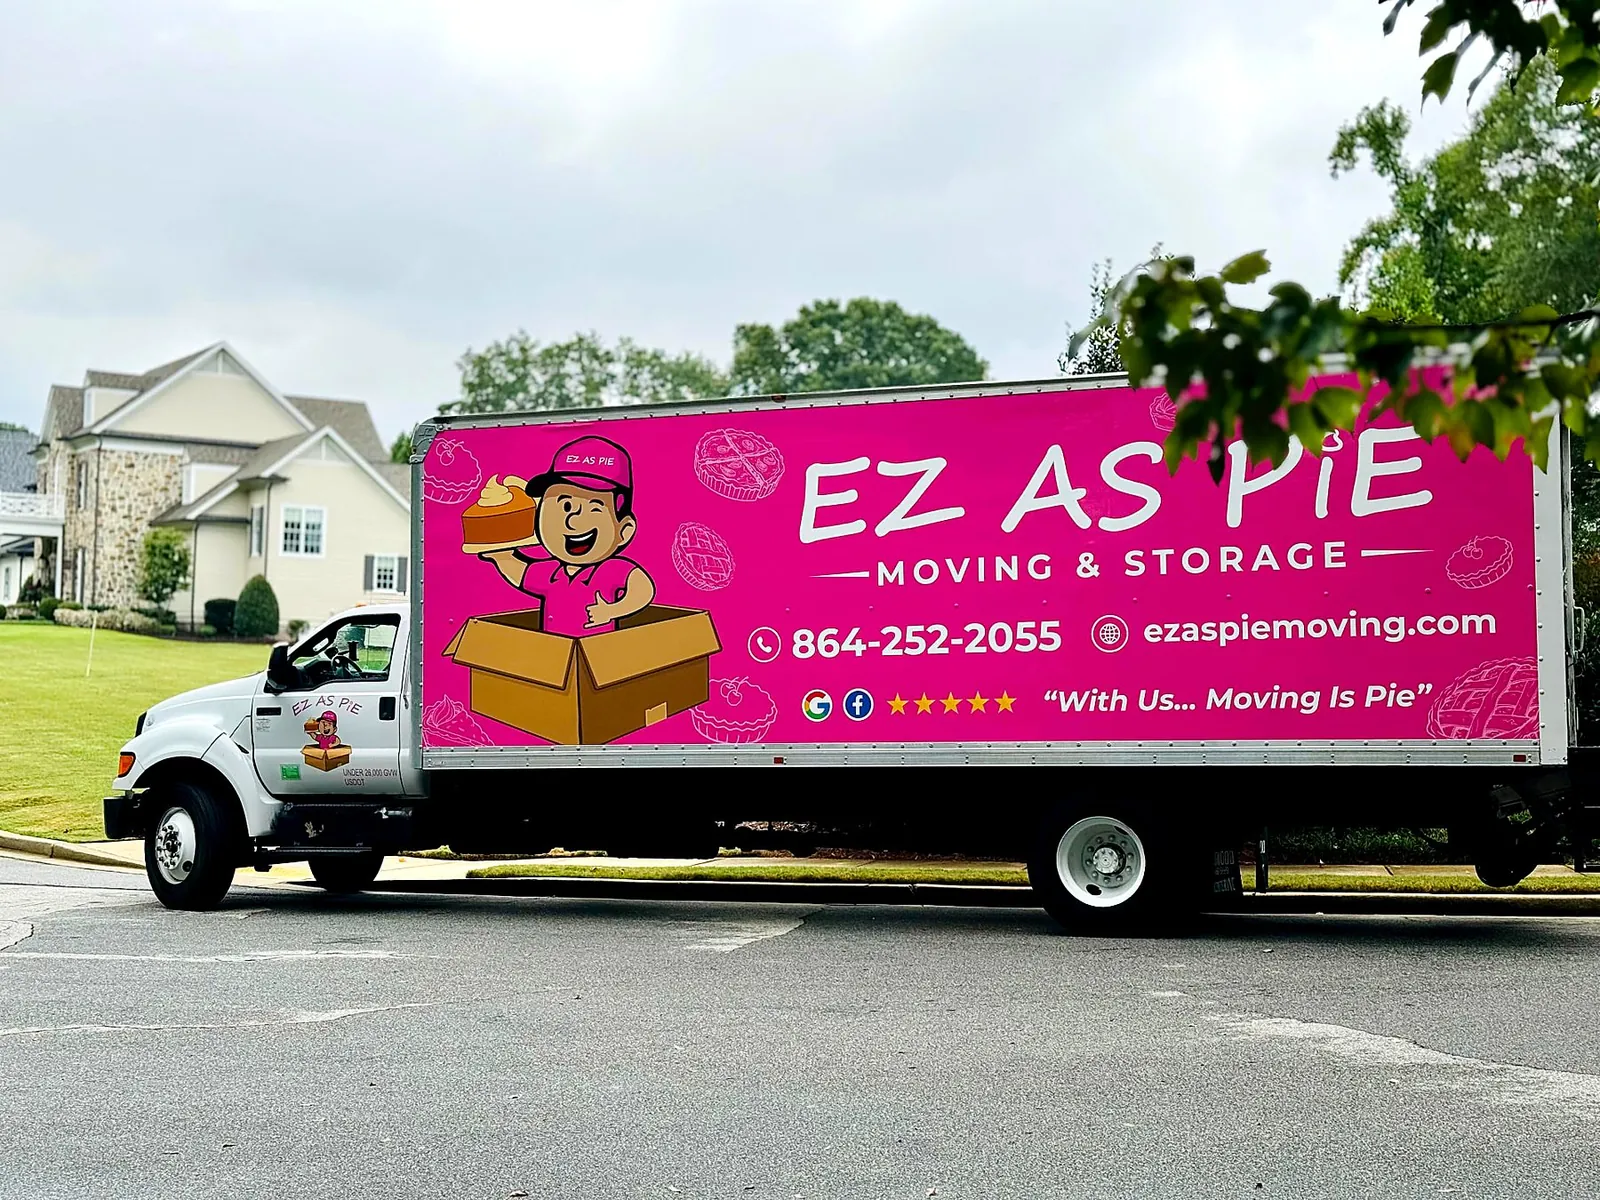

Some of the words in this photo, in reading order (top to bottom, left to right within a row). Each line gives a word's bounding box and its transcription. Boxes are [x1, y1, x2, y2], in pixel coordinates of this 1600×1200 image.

[566, 455, 580, 463] EZ
[582, 456, 595, 465] AS
[800, 456, 966, 544] EZ
[1001, 441, 1163, 533] AS
[877, 553, 1051, 587] MOVING
[1077, 552, 1101, 579] &
[1124, 541, 1347, 576] STORAGE
[792, 620, 1062, 659] 864-252-2055
[1143, 609, 1496, 647] ezaspiemoving.com
[292, 699, 313, 716] EZ
[315, 695, 335, 706] AS
[1044, 688, 1128, 713] “With
[1138, 689, 1196, 712] Us...
[1206, 684, 1321, 715] Moving
[1330, 685, 1356, 708] Is
[1365, 682, 1434, 708] Pie”
[343, 768, 364, 777] UNDER
